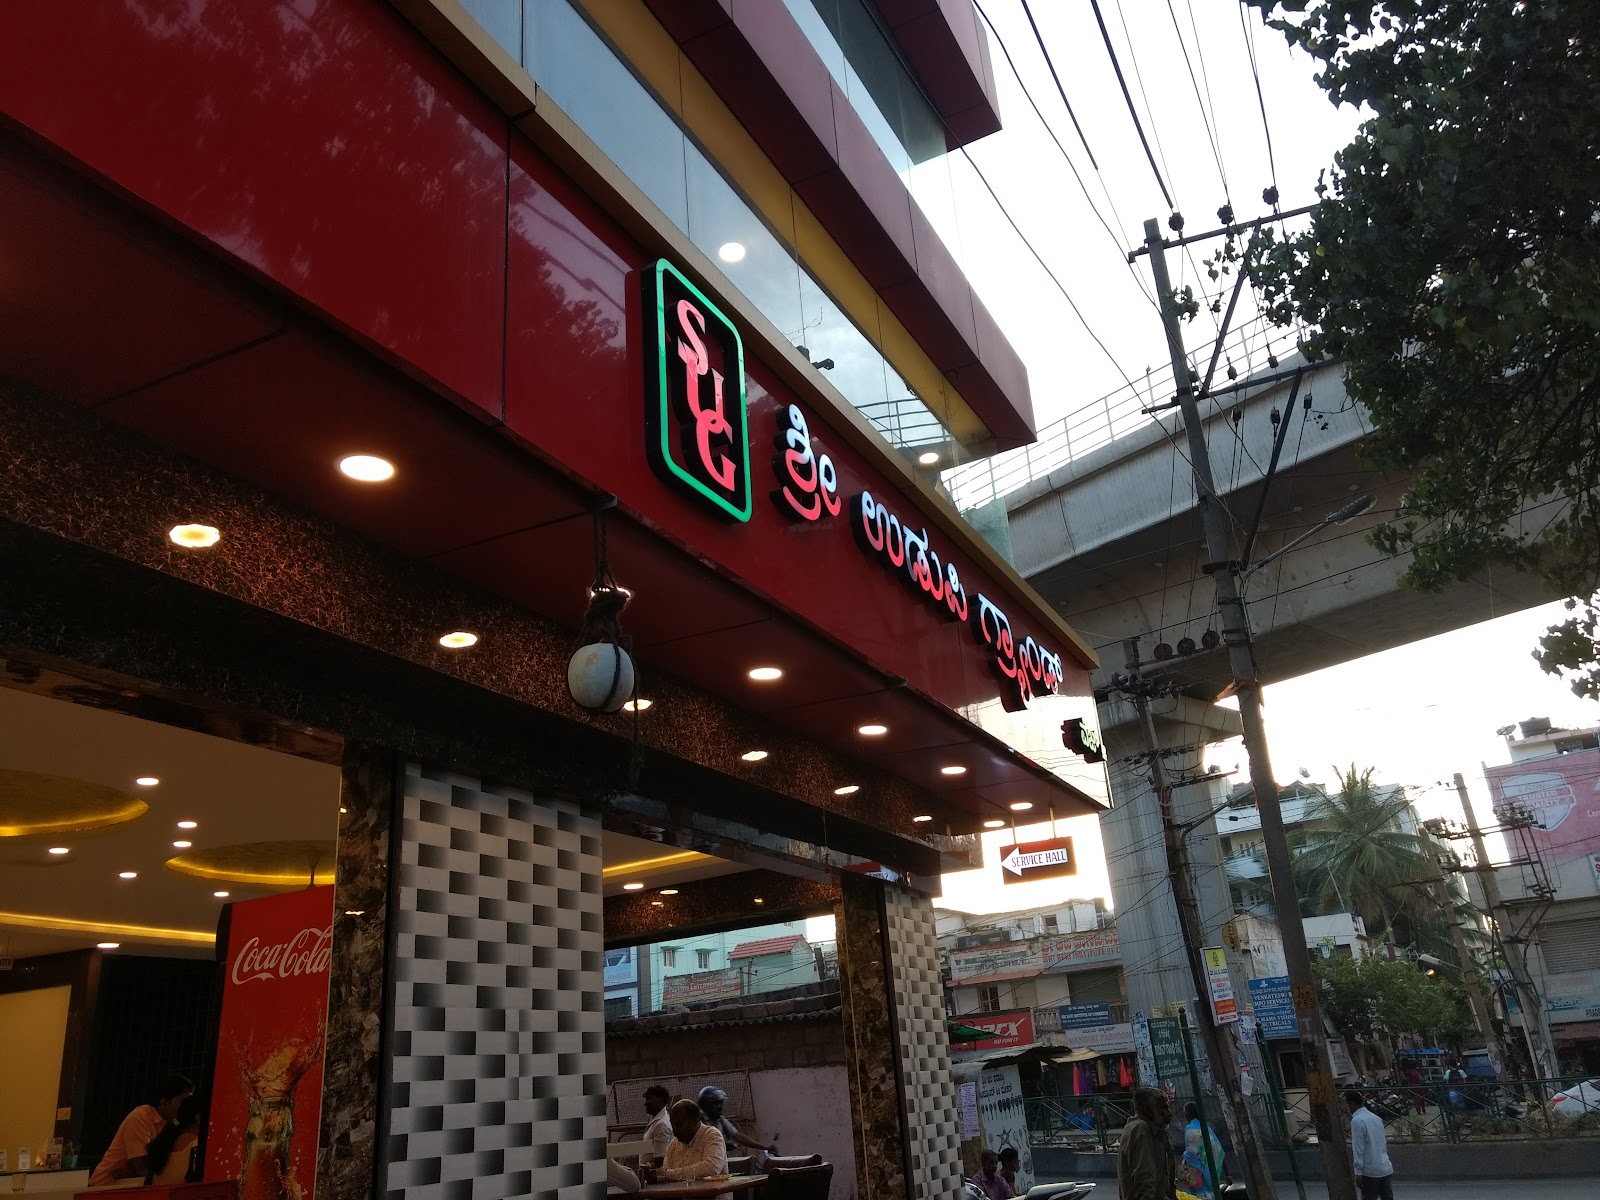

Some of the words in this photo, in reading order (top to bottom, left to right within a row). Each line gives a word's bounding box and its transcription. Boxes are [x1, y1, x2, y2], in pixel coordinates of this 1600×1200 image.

[783, 403, 842, 520] ಶ್ರೀ
[860, 490, 969, 621] ಉಡುಪಿ
[1011, 853, 1044, 868] SERVICE
[1045, 850, 1067, 863] HALL
[231, 925, 333, 985] Coca-Cola
[1072, 948, 1106, 960] INSTITUTE
